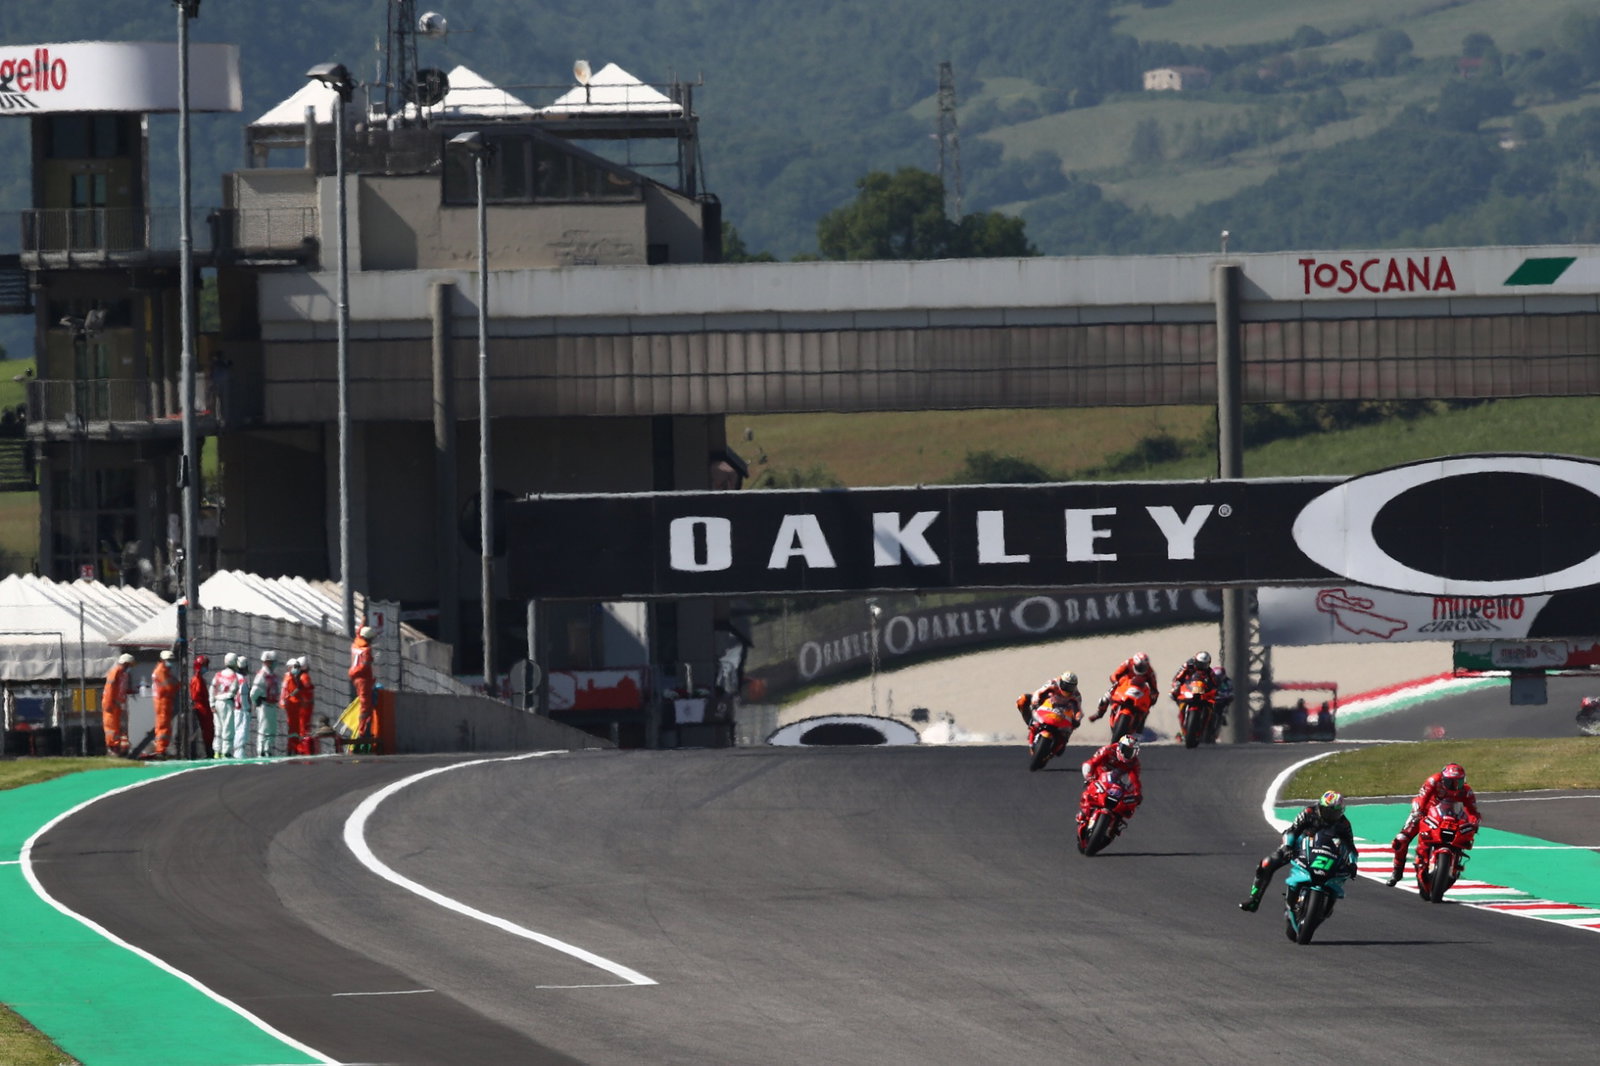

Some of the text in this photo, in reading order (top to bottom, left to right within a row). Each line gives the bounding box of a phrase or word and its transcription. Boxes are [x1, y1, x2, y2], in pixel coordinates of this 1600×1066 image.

[1298, 256, 1456, 299] TOSCANA
[668, 504, 1215, 573] OAKLEY
[1065, 588, 1184, 623] OAKLEY
[916, 606, 1005, 642] OAKLEY
[1418, 619, 1502, 632] CIRCUIT
[1310, 855, 1335, 870] 21
